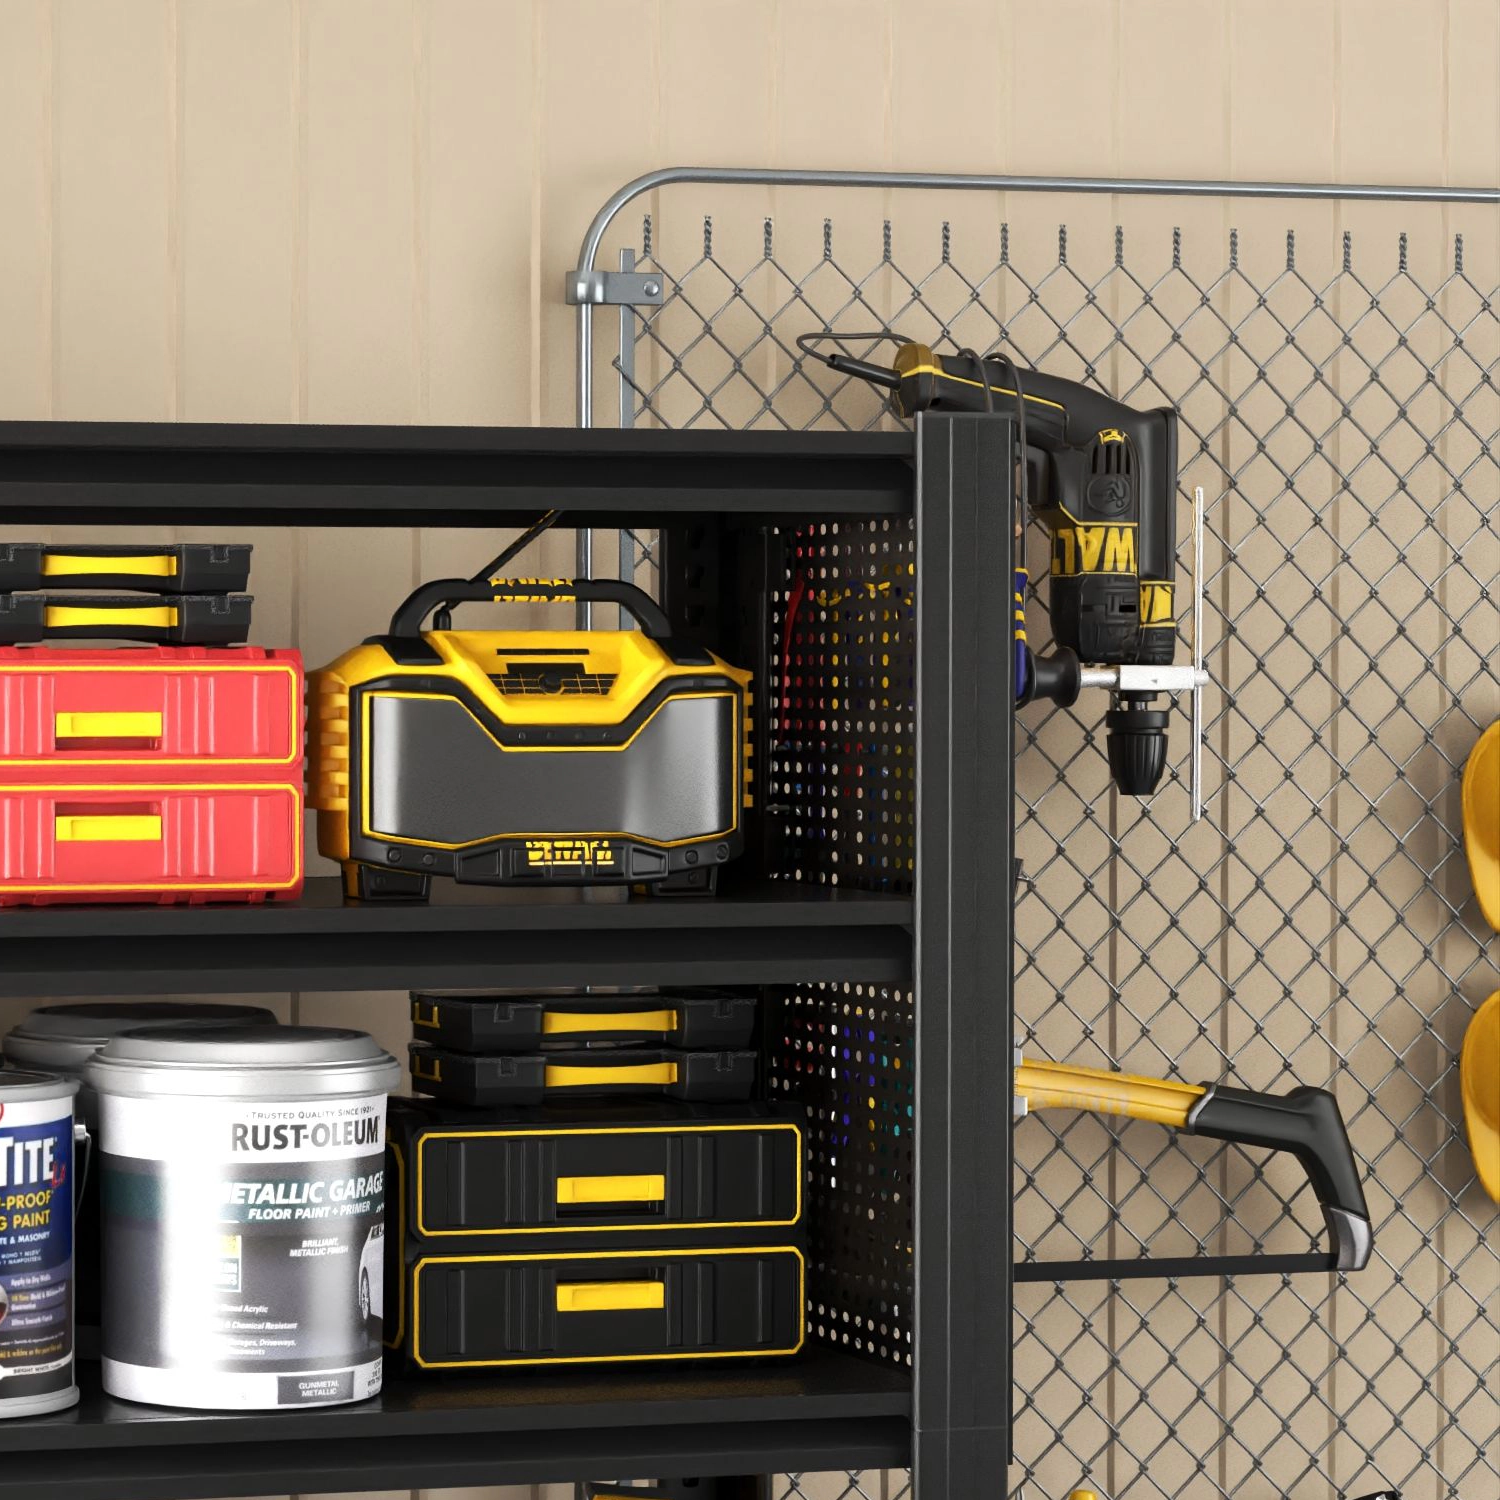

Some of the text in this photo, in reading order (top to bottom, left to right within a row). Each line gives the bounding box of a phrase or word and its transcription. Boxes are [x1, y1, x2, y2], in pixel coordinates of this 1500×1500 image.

[251, 1111, 295, 1120] TRUSTED
[297, 1109, 336, 1120] QUALITY
[337, 1107, 359, 1117] SINCE
[231, 1115, 380, 1153] RUST-OLEUM
[328, 1170, 385, 1202] GARAGE
[247, 1207, 292, 1221] FLOOR
[294, 1206, 331, 1220] PAINT
[339, 1201, 371, 1216] PRIMER
[12, 1209, 51, 1230] PAINT
[17, 1231, 51, 1244] MASONRY
[289, 1247, 326, 1257] METALLIC
[243, 1304, 269, 1315] Acrylic
[231, 1321, 265, 1330] Chemical
[265, 1322, 298, 1330] Resistant
[298, 1379, 341, 1391] GUNMETAL
[301, 1387, 338, 1398] METALLIC
